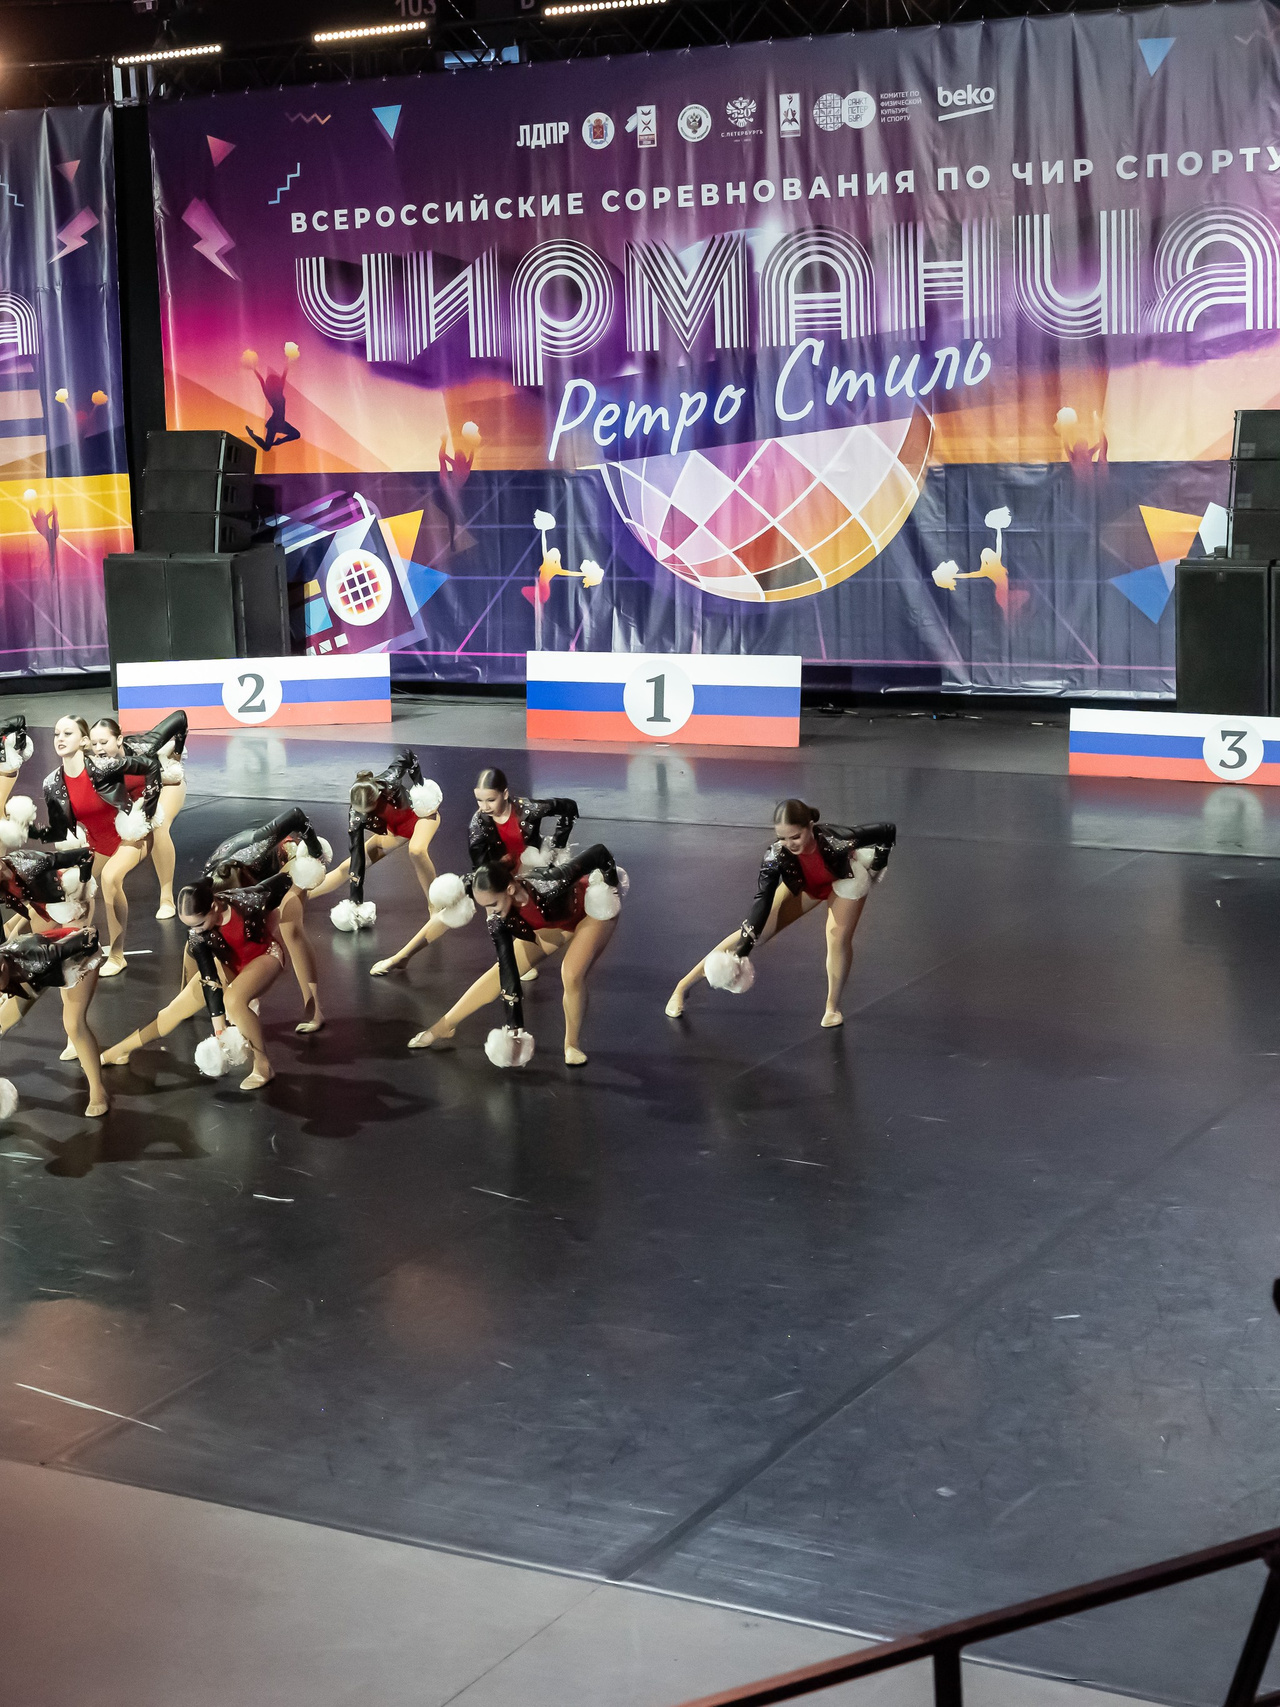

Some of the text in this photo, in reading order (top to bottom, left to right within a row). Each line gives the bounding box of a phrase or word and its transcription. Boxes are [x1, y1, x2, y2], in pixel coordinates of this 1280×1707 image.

[880, 91, 909, 99] КОМИТЕТ
[880, 98, 922, 107] ФИЗИЧЕСКОЙ
[937, 84, 996, 108] beko
[880, 107, 909, 115] КУЛЬТУРЕ
[887, 115, 911, 123] СПОРТУ
[517, 121, 570, 149] ЛДПР
[291, 146, 1280, 233] ВСЕРОССИЙСКИЕ СОРЕВНОВАНИЯ ПО ЧИР СПОРТУ
[548, 337, 993, 462] Ретро Стиль
[237, 673, 267, 713] 2
[646, 673, 671, 722] 1
[1219, 729, 1248, 770] 3
